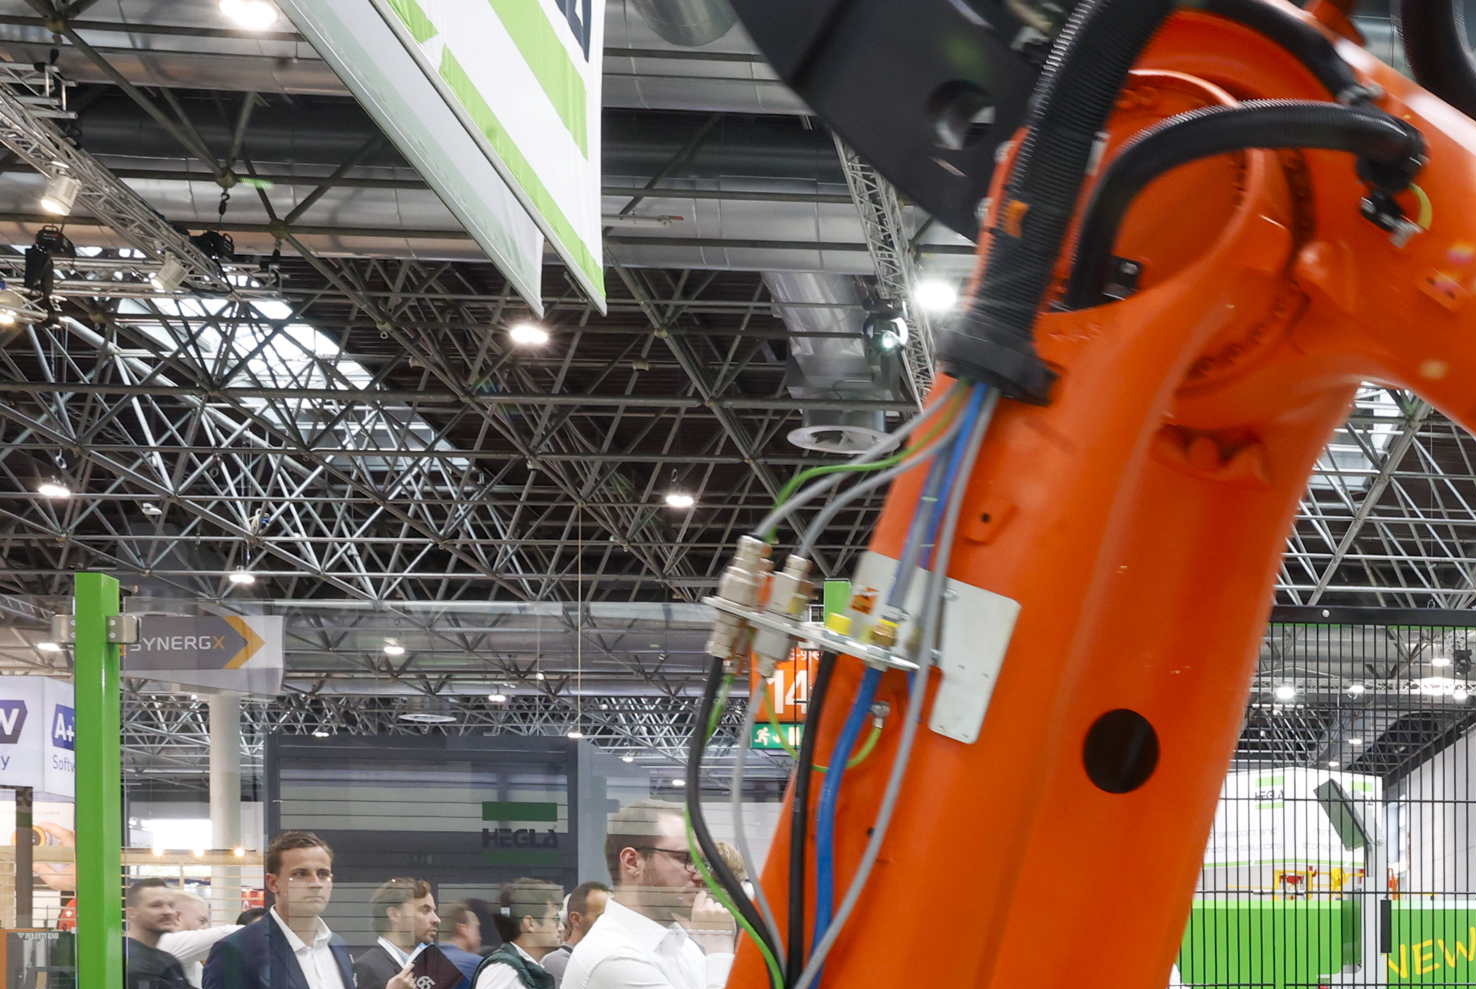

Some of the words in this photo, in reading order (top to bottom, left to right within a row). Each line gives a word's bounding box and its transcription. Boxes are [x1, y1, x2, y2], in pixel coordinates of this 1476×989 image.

[766, 669, 808, 715] 14
[54, 712, 76, 743] A+
[482, 827, 559, 849] HEGLA
